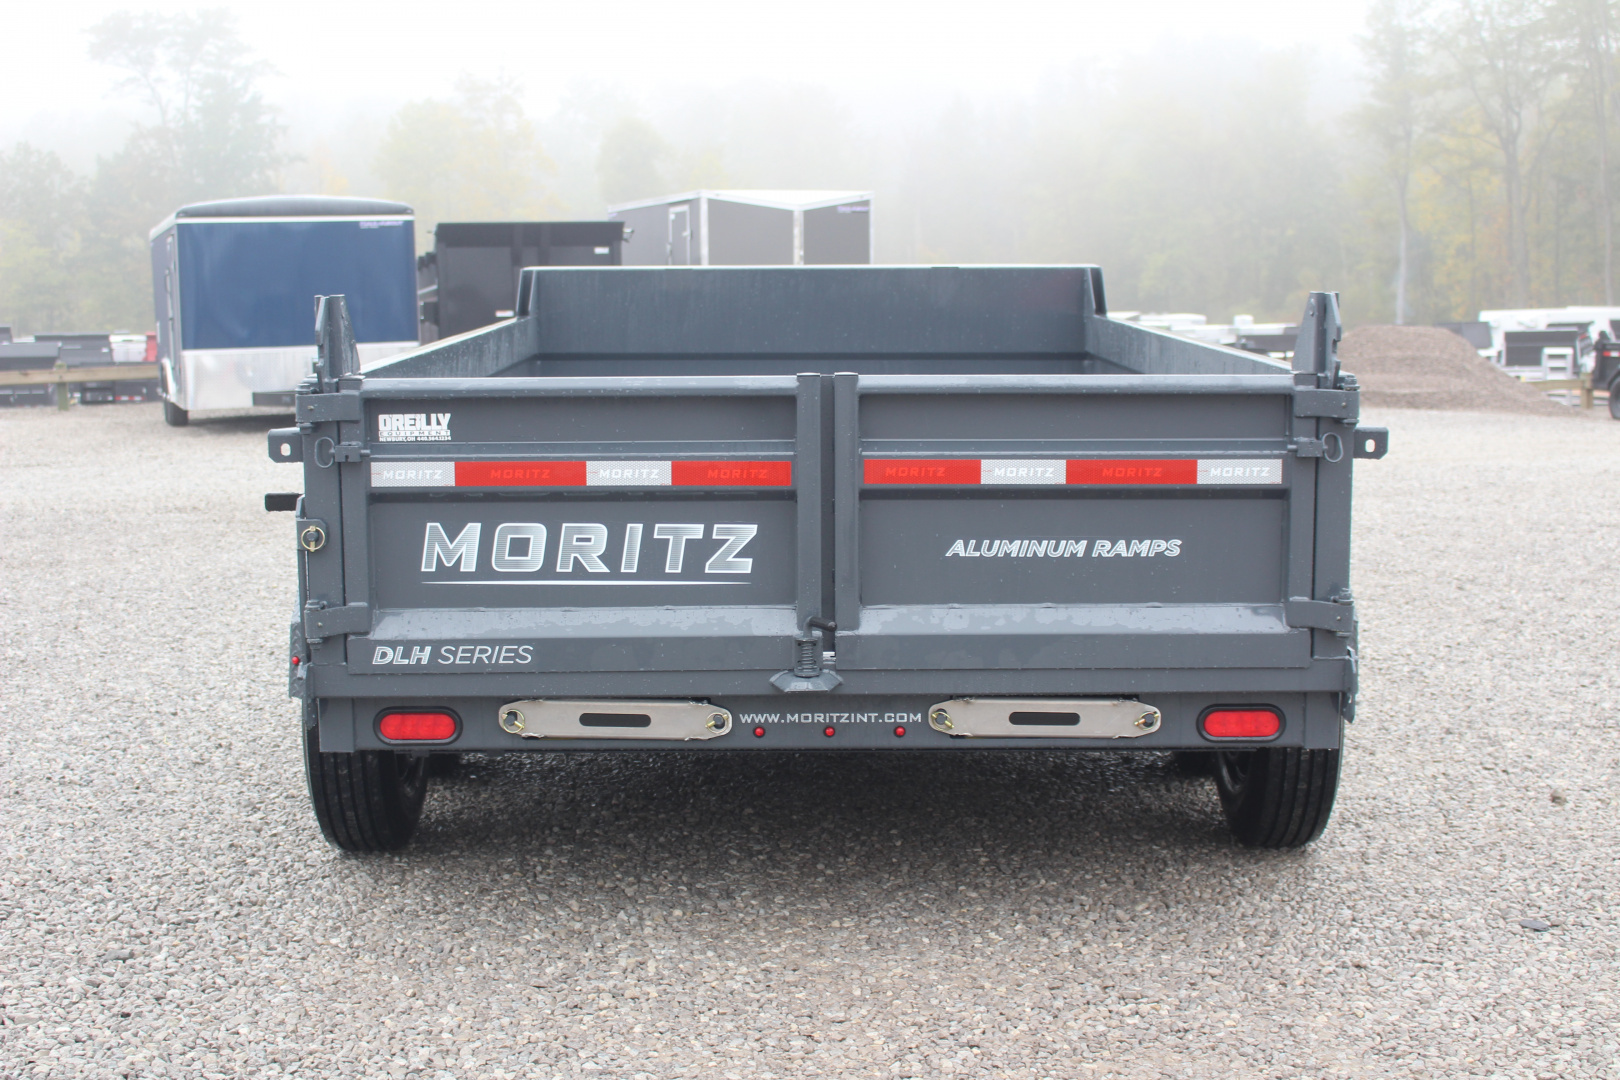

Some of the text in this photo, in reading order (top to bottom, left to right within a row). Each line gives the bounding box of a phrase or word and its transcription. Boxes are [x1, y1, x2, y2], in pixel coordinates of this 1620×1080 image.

[382, 469, 444, 480] MORITZ
[490, 469, 550, 479] MORITZ
[599, 468, 660, 479] MORITZ
[707, 468, 768, 479] MORITZ
[885, 467, 946, 477] MORITZ
[994, 467, 1055, 477] MORITZ
[1102, 467, 1163, 477] MORITZ
[1210, 467, 1271, 477] MORITZ
[421, 522, 758, 574] MORITZ
[945, 539, 1182, 557] ALUMINUM RAMPS
[372, 645, 534, 665] DLH SERIES
[739, 713, 922, 723] WWW.MORITZINT.COM
